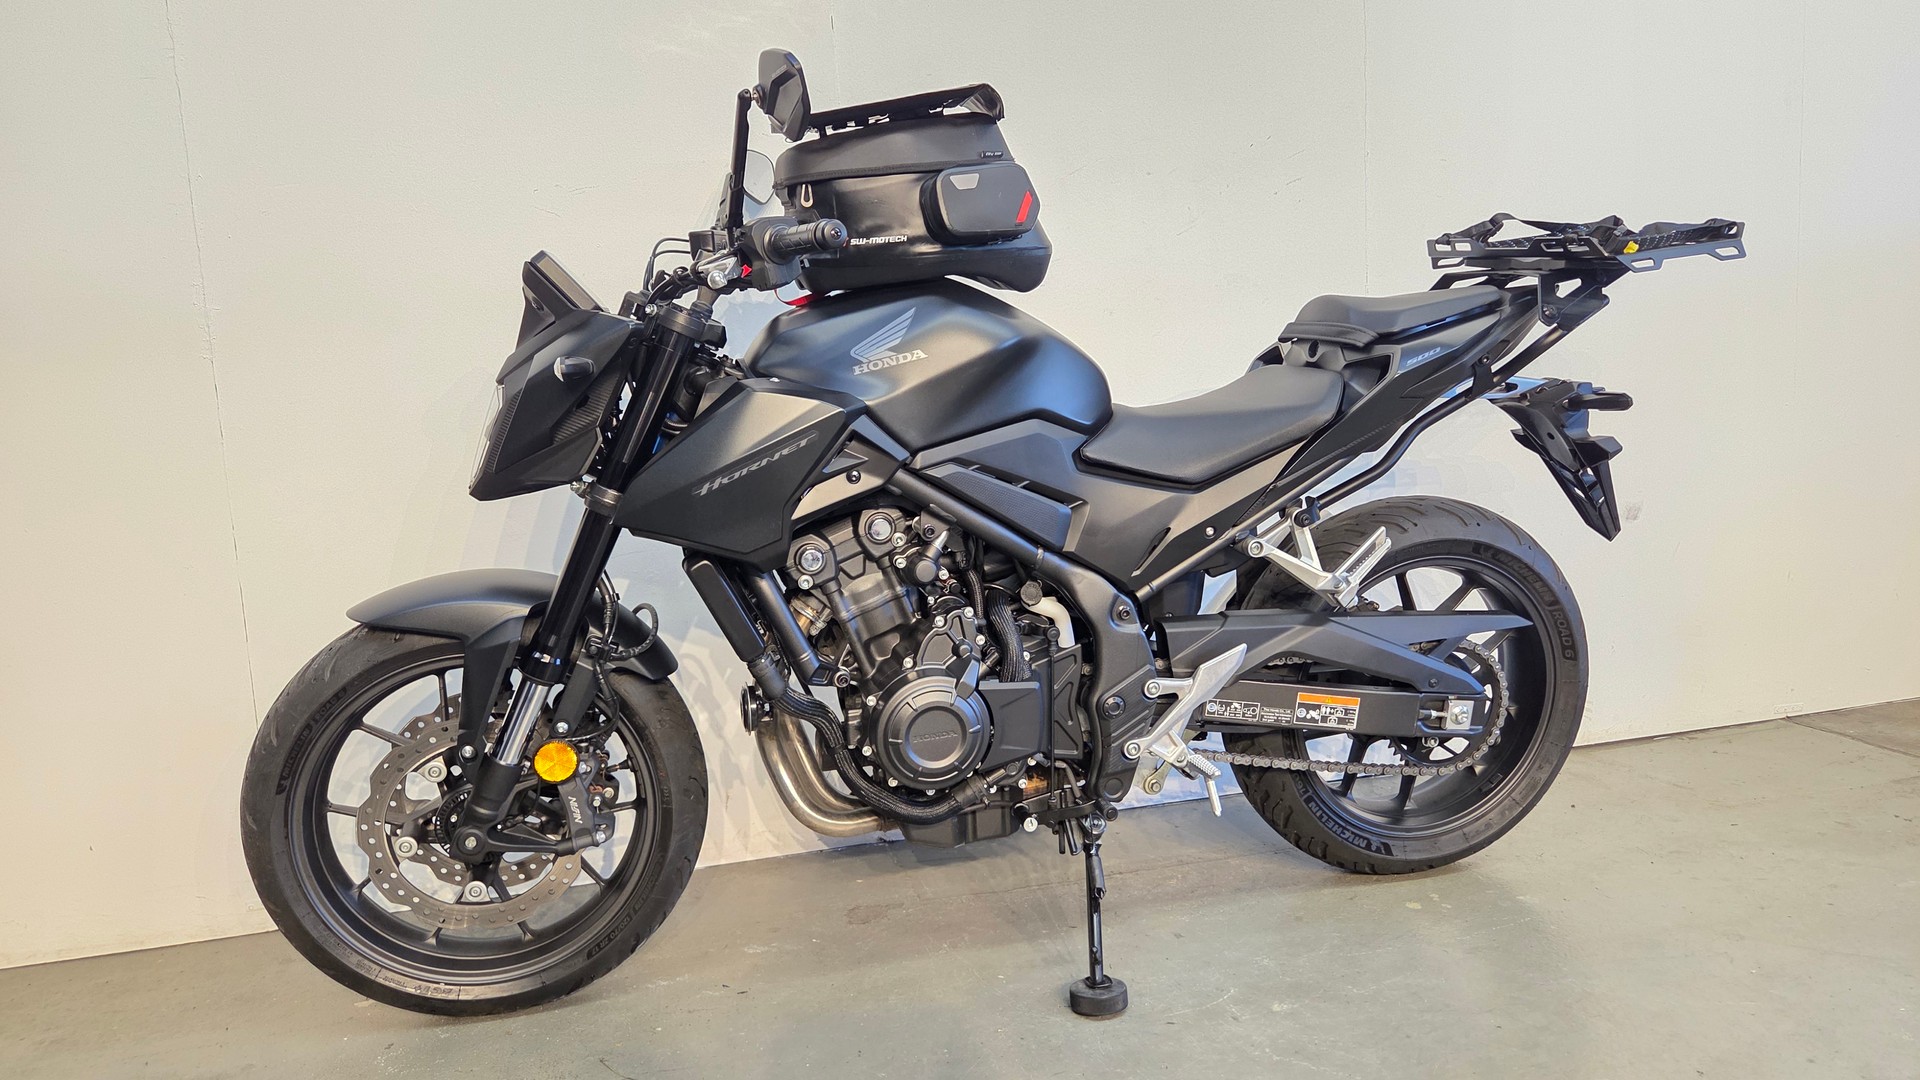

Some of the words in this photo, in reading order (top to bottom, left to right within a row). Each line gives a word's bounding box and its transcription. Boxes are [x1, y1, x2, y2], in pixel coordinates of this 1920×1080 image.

[850, 235, 908, 246] SW-MOTECH
[852, 349, 929, 376] HONDA
[1406, 346, 1441, 367] 500
[691, 432, 817, 497] HORNET
[1553, 610, 1573, 646] ROAD
[1563, 649, 1575, 660] 6
[912, 730, 959, 744] HONDA
[1307, 800, 1369, 849] MICHELIN
[609, 914, 632, 940] 120/70
